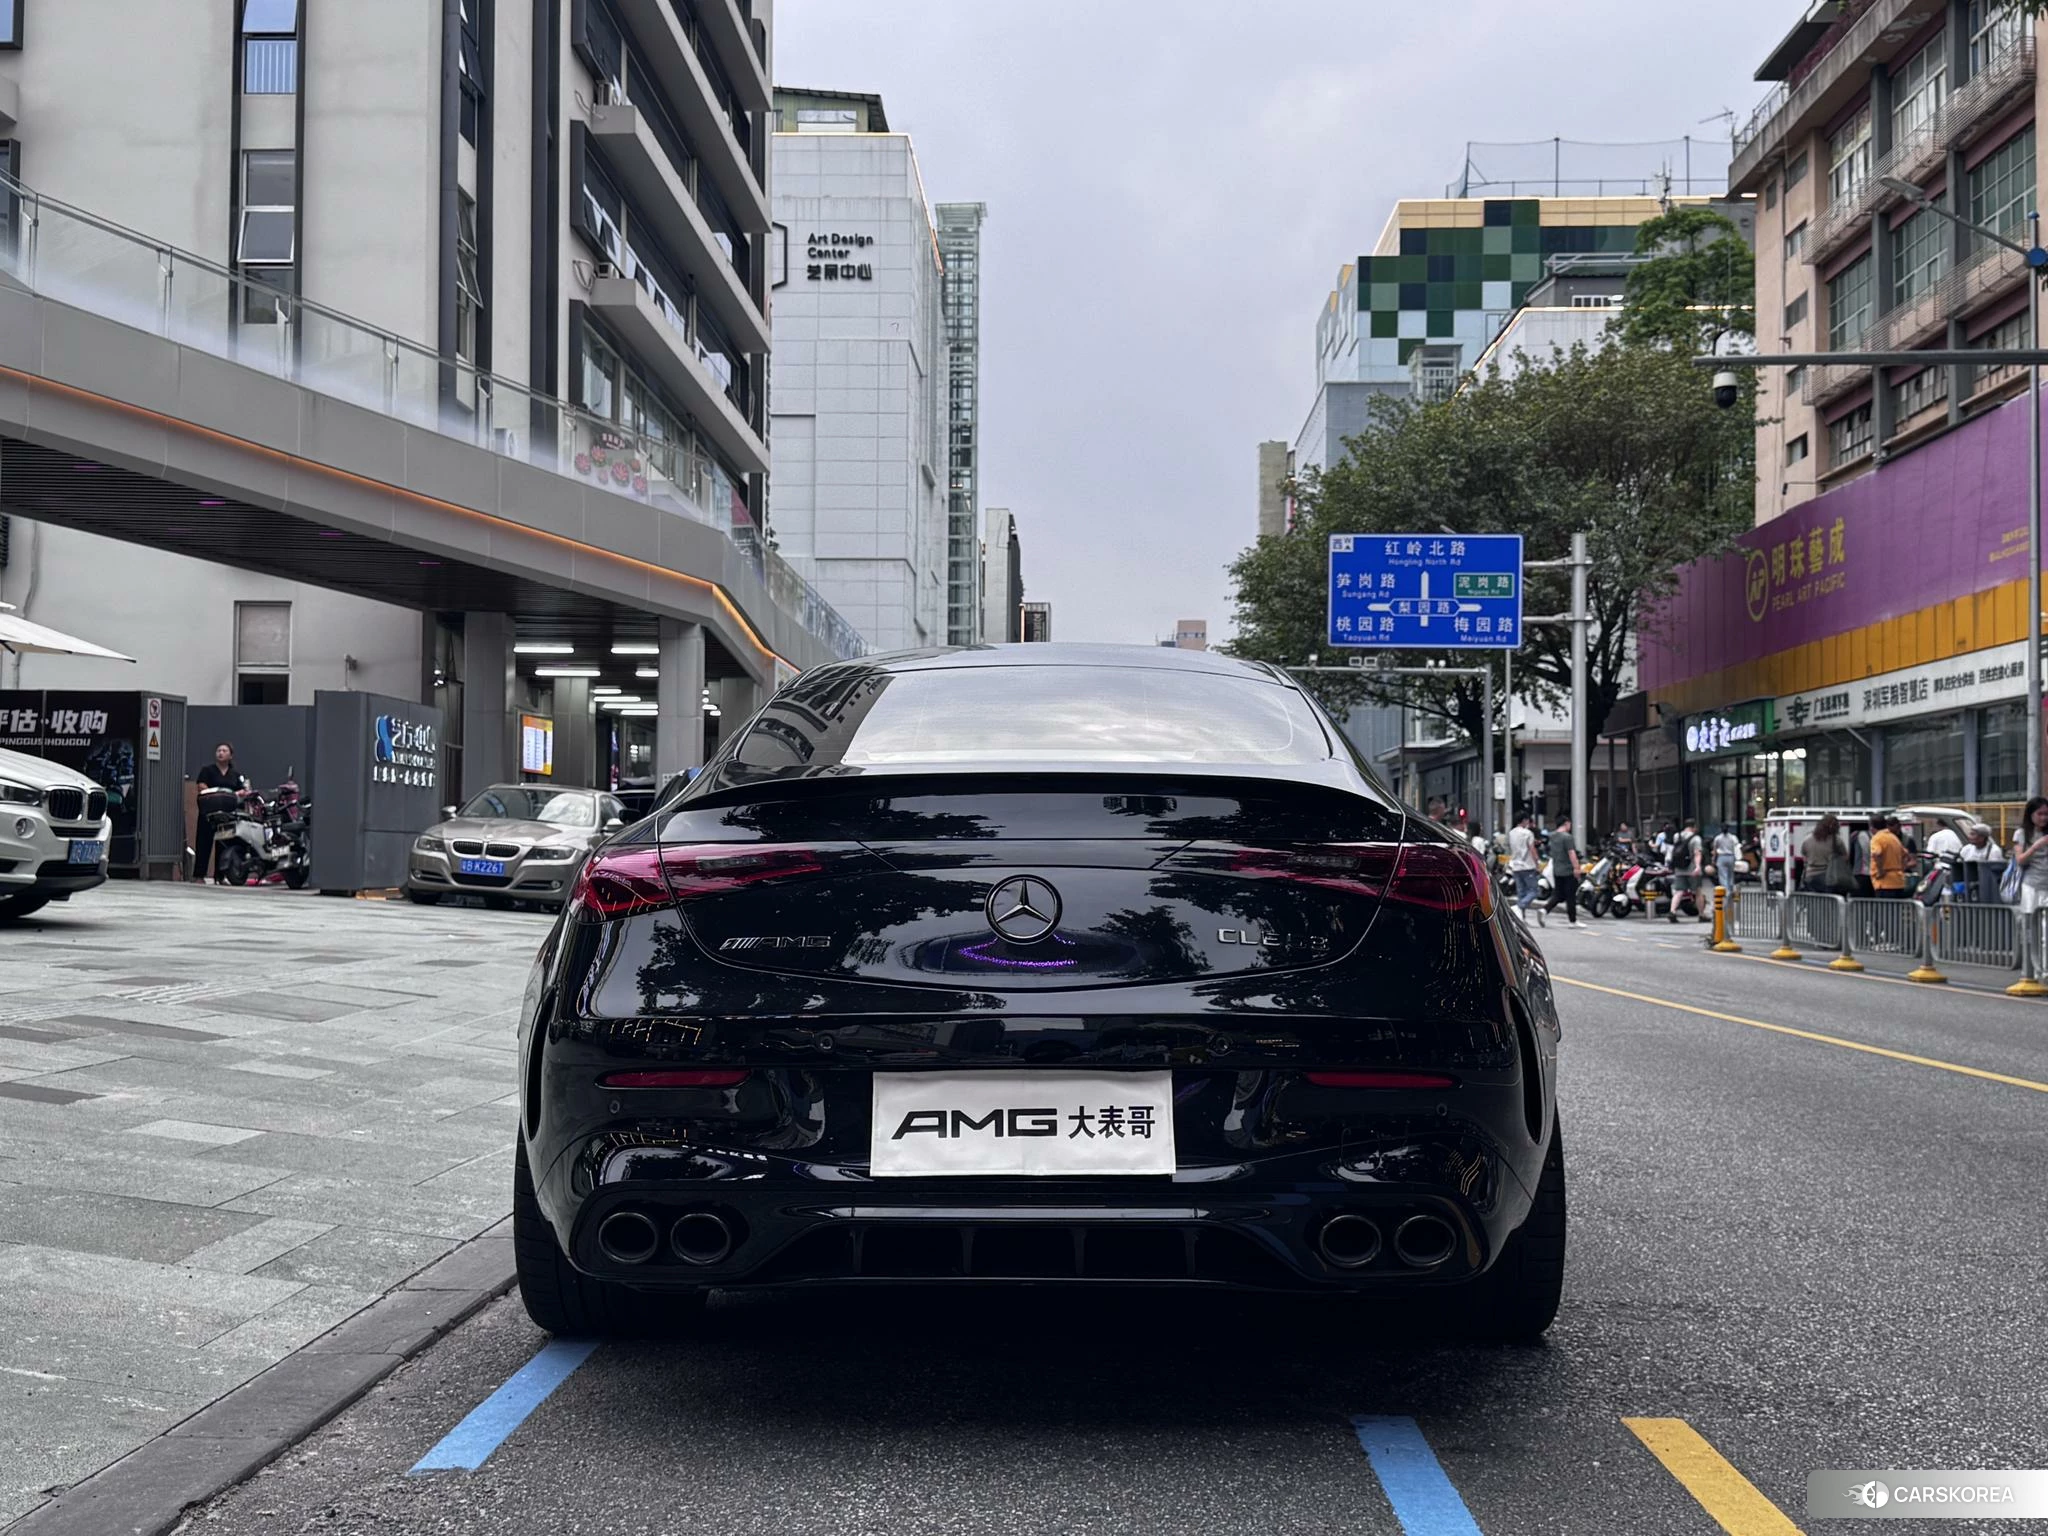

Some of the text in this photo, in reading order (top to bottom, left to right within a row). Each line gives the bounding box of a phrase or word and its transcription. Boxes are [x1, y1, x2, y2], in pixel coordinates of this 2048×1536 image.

[807, 233, 873, 247] Art Design
[807, 247, 850, 259] Center
[1384, 540, 1466, 556] 红岭北路
[1388, 558, 1423, 567] Hongling
[1450, 558, 1461, 566] Rd
[1336, 573, 1396, 589] 笋岗路
[1342, 590, 1390, 599] Sungang Rd
[1772, 591, 1794, 611] PEARL
[1336, 616, 1395, 632] 桃园路
[1455, 617, 1513, 632] 梅园路
[1343, 633, 1390, 642] Taoyuan Rd
[1461, 634, 1494, 643] Meiyuan
[891, 1105, 1156, 1140] AMG 大表哥
